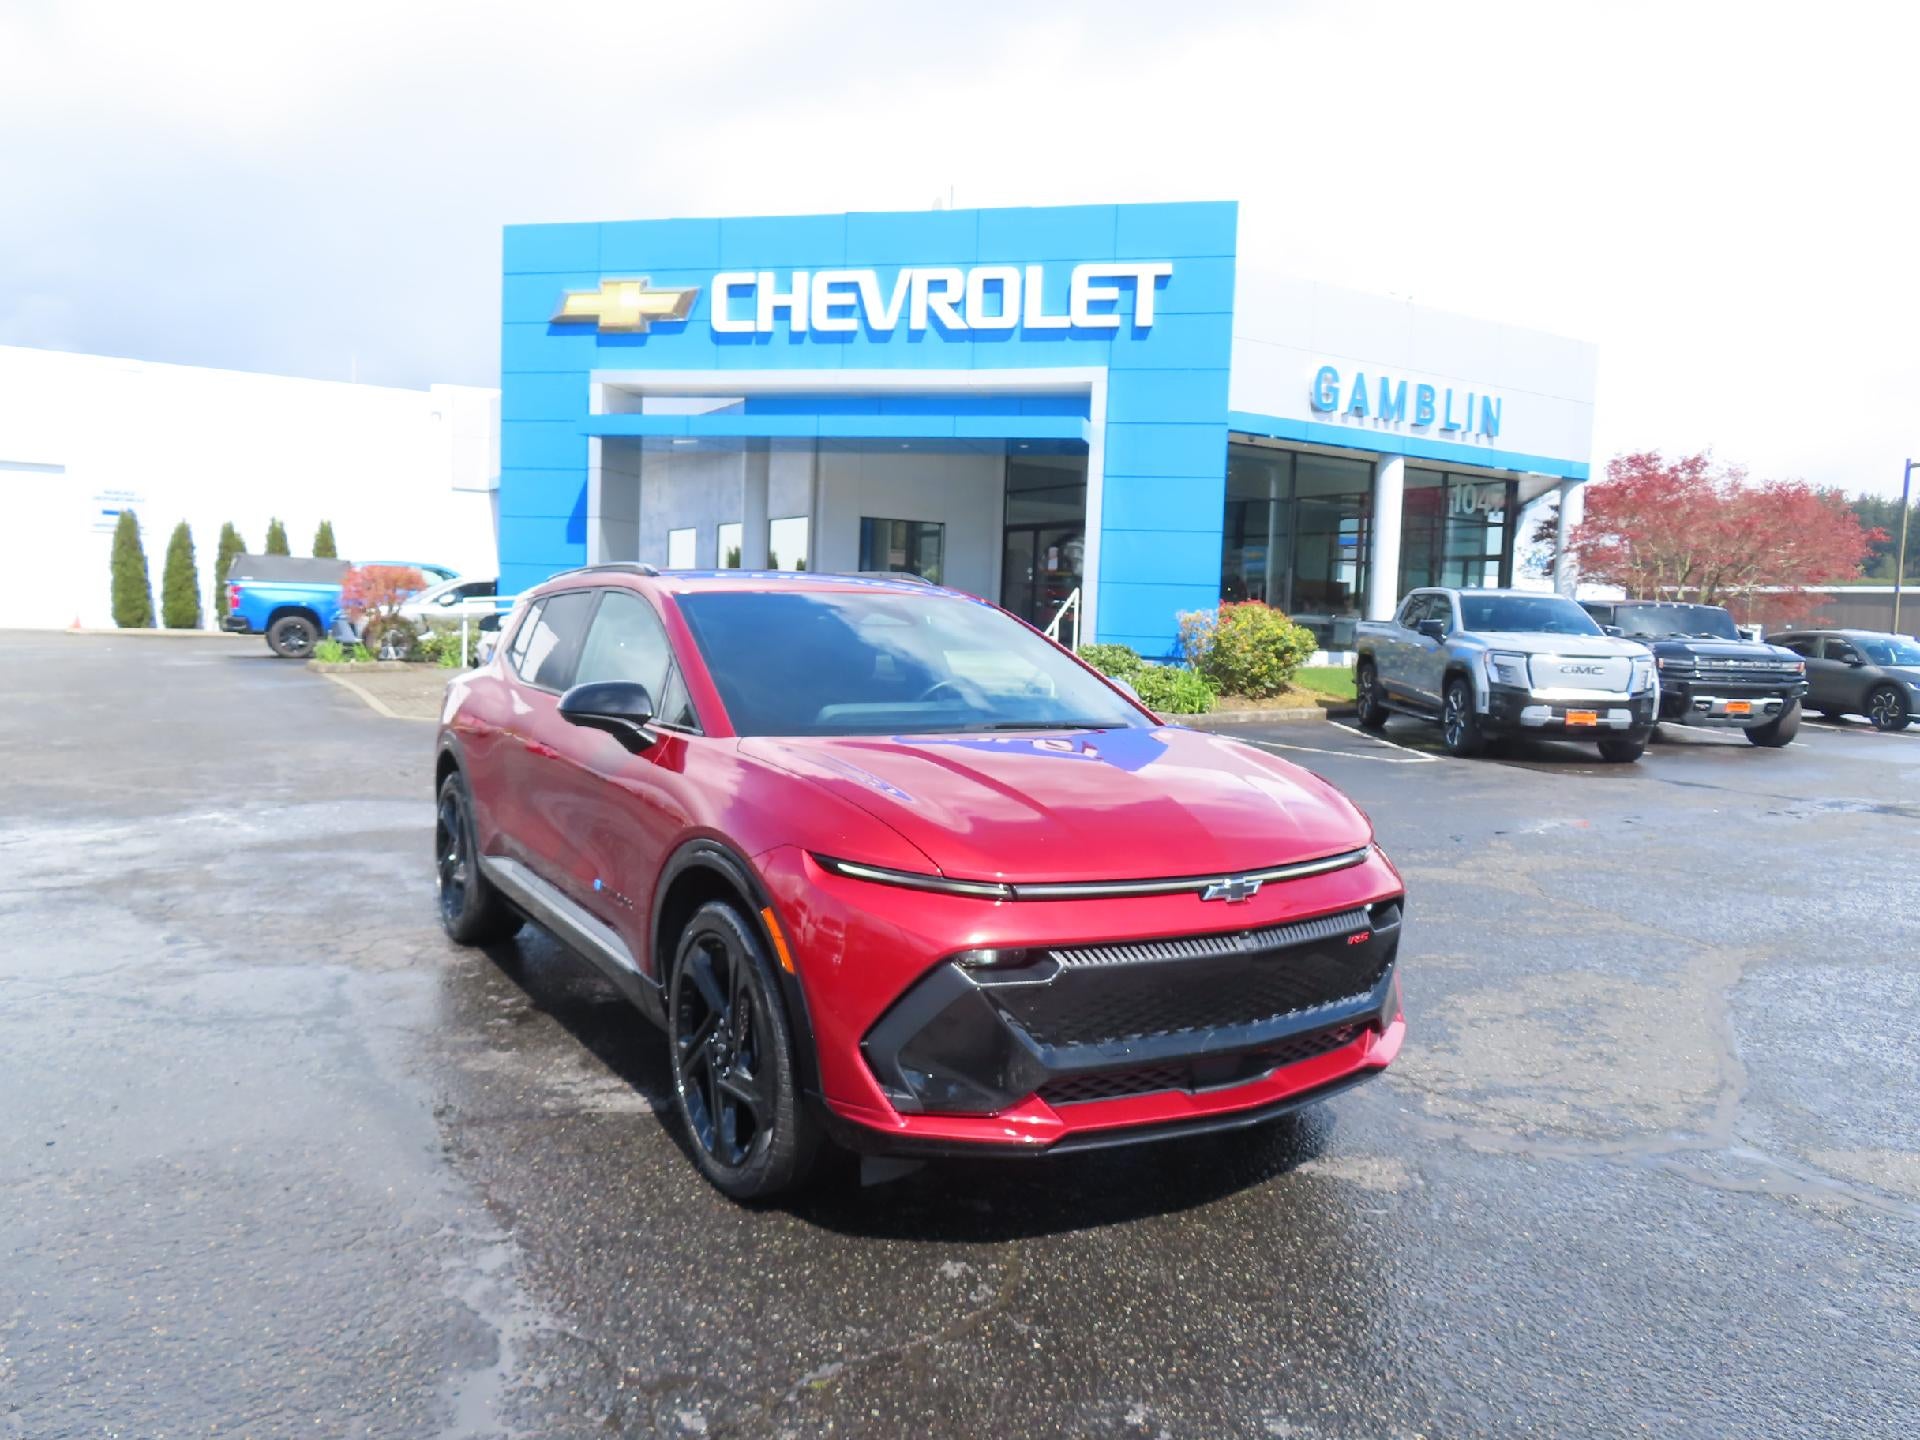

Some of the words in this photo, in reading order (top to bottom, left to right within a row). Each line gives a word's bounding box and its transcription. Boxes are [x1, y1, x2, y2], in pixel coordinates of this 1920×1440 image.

[710, 262, 1173, 333] CHEVROLET
[1311, 365, 1503, 437] GAMBLIN
[1559, 665, 1605, 676] GMC
